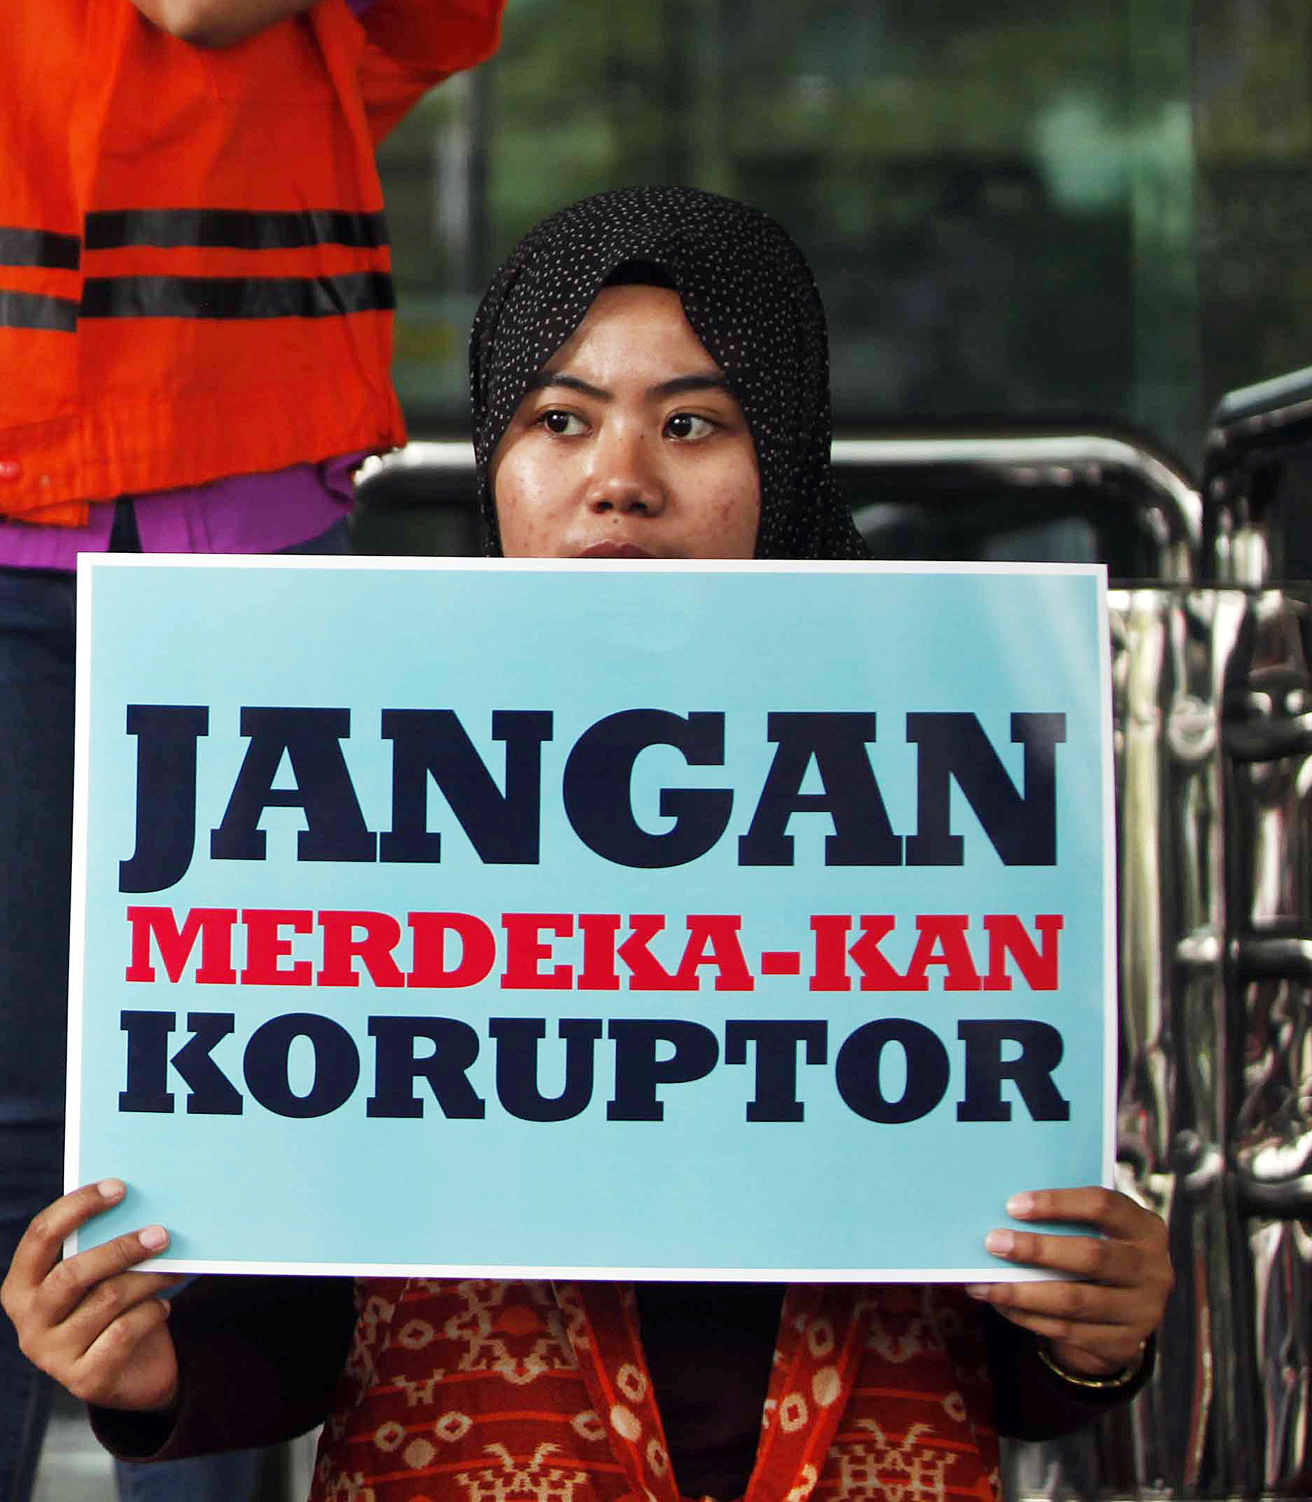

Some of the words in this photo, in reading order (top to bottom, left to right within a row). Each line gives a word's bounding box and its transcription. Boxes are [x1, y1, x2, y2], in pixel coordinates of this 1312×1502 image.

[118, 704, 1066, 894] JANGAN
[125, 906, 1064, 992] MERDEKA-KAN
[118, 1010, 1071, 1125] KORUPTOR
